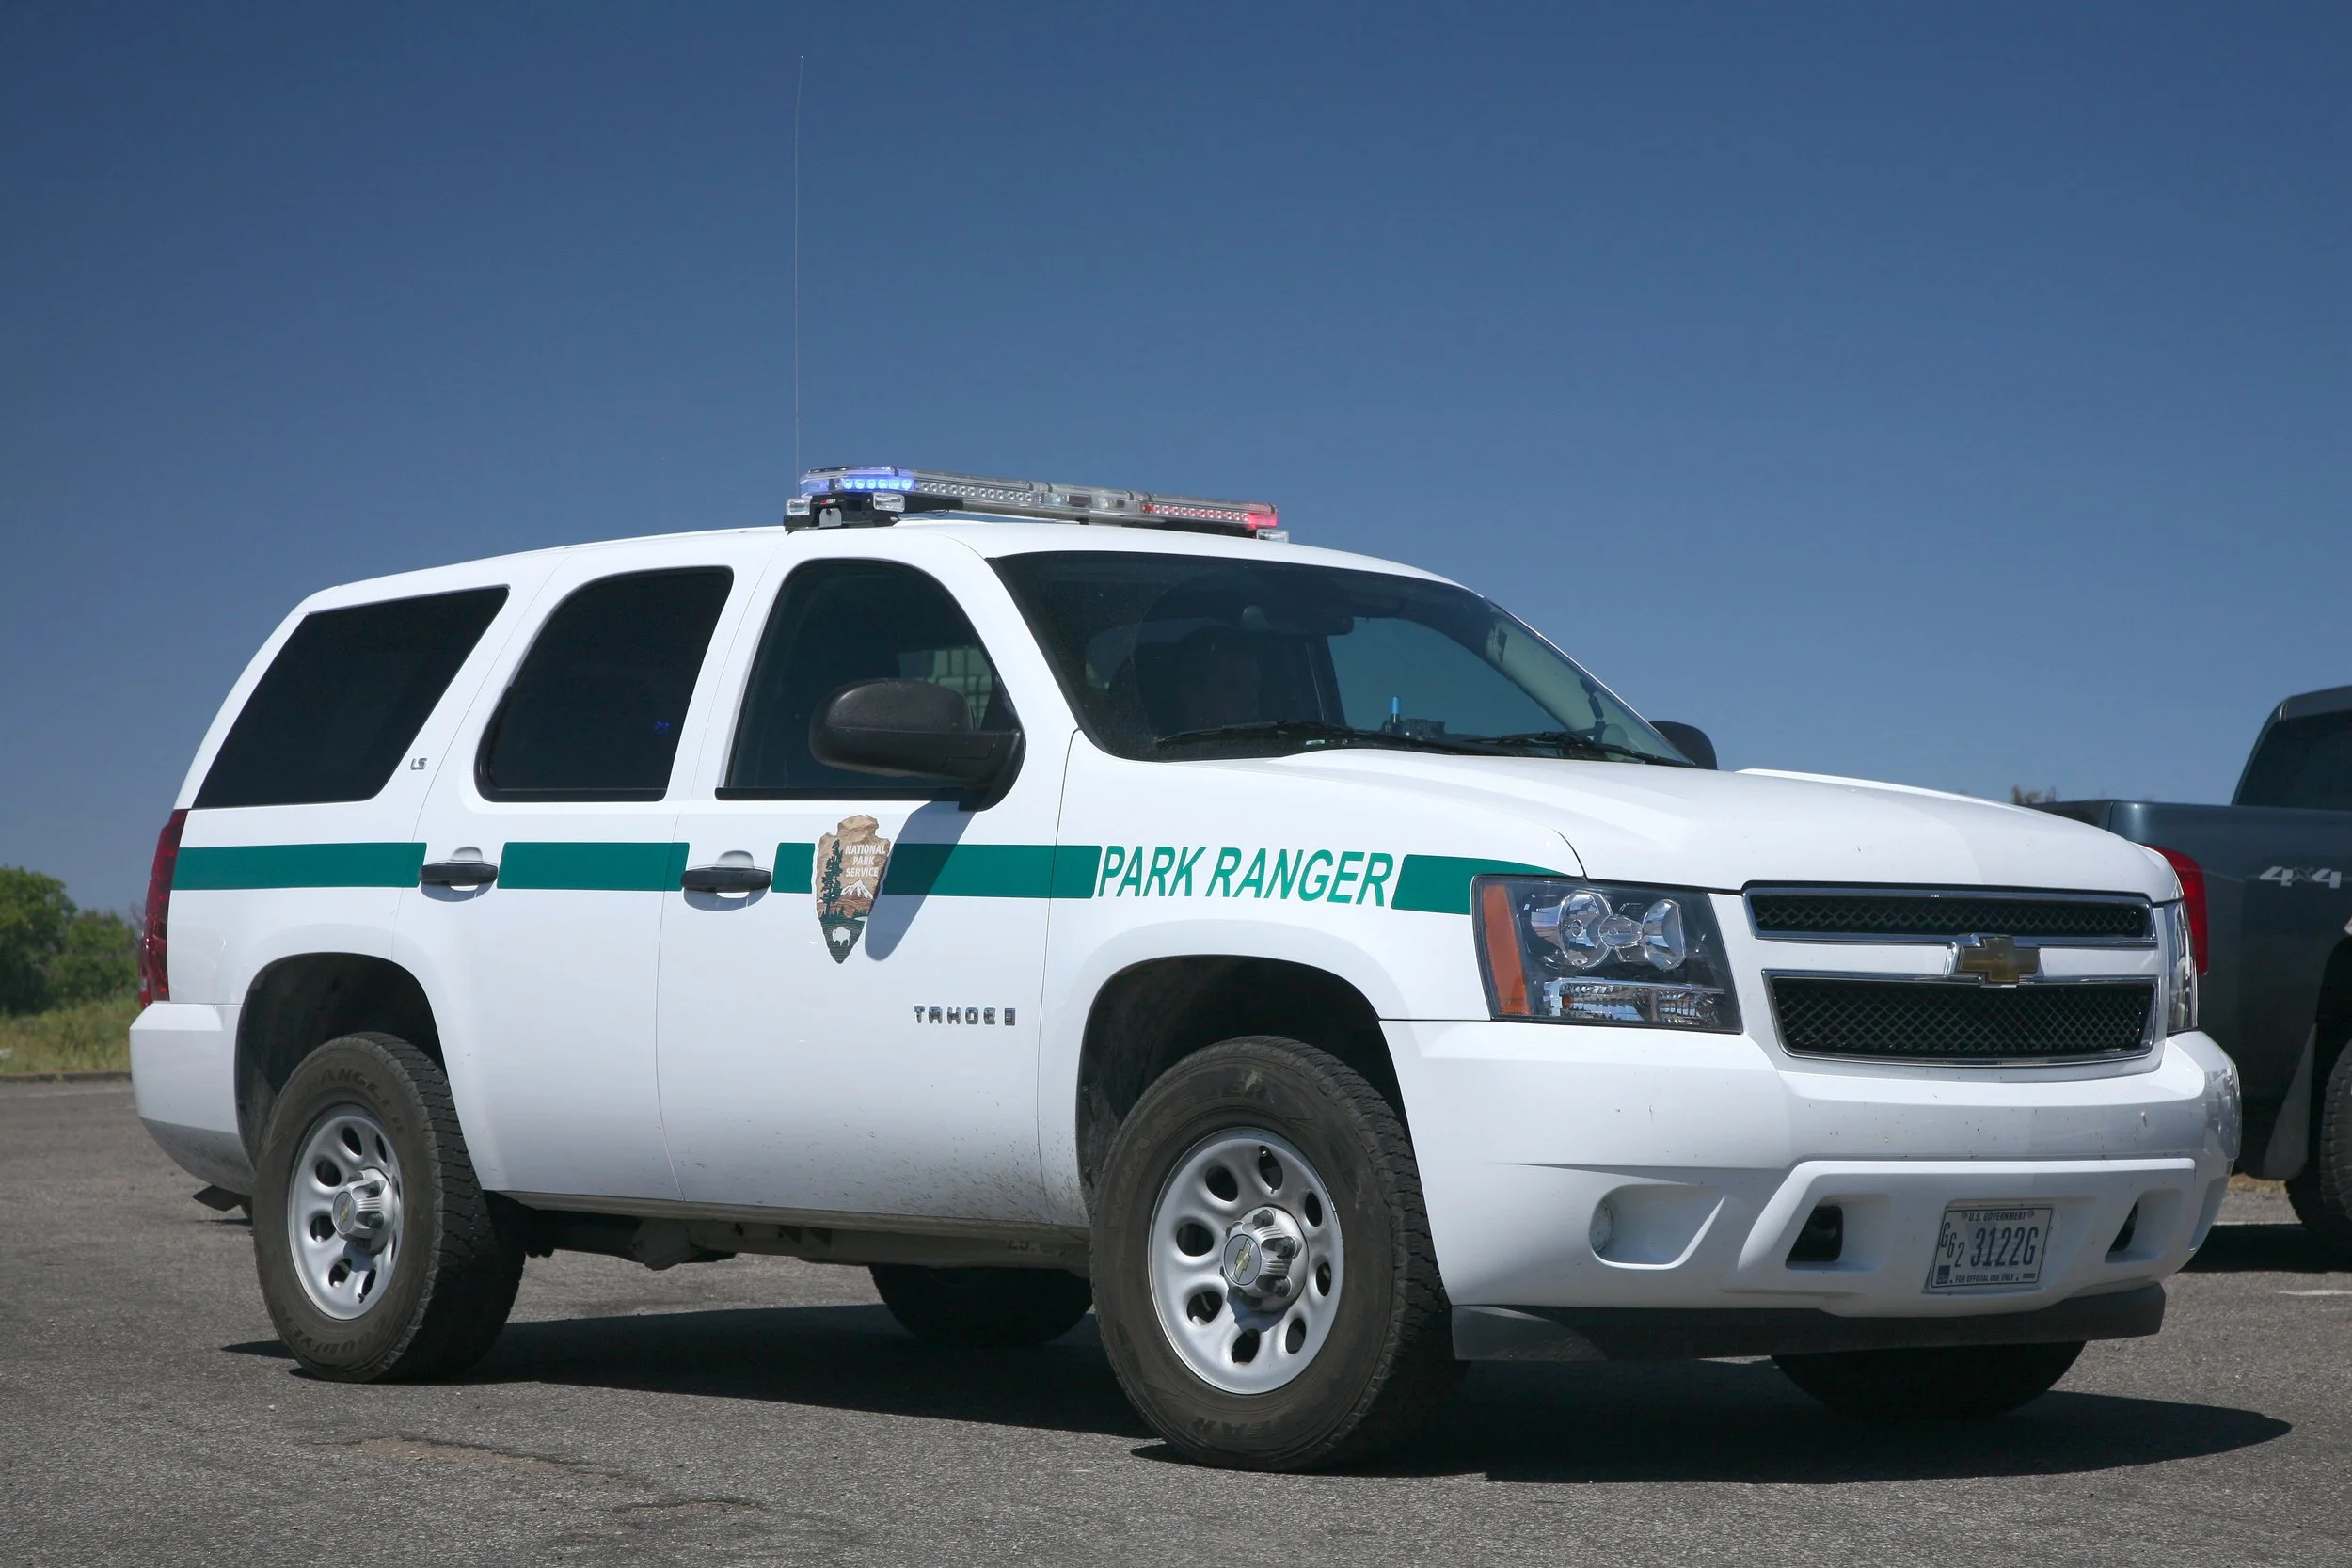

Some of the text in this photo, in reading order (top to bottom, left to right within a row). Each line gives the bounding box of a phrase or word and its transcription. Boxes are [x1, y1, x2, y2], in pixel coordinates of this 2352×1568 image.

[410, 757, 428, 770] LS
[845, 844, 886, 855] NATIONAL
[852, 856, 875, 866] PARK
[846, 867, 880, 878] SERVICE
[1097, 845, 1394, 908] PARK RANGER
[914, 1006, 996, 1025] TAHOE
[1968, 1211, 2027, 1222] U.S. GOVERNMENT
[1970, 1226, 2040, 1267] 3122G
[1955, 1275, 1966, 1283] FOR
[1966, 1274, 1989, 1283] OFFICIAL
[1990, 1274, 2002, 1282] USE
[2001, 1273, 2015, 1282] ONLY
